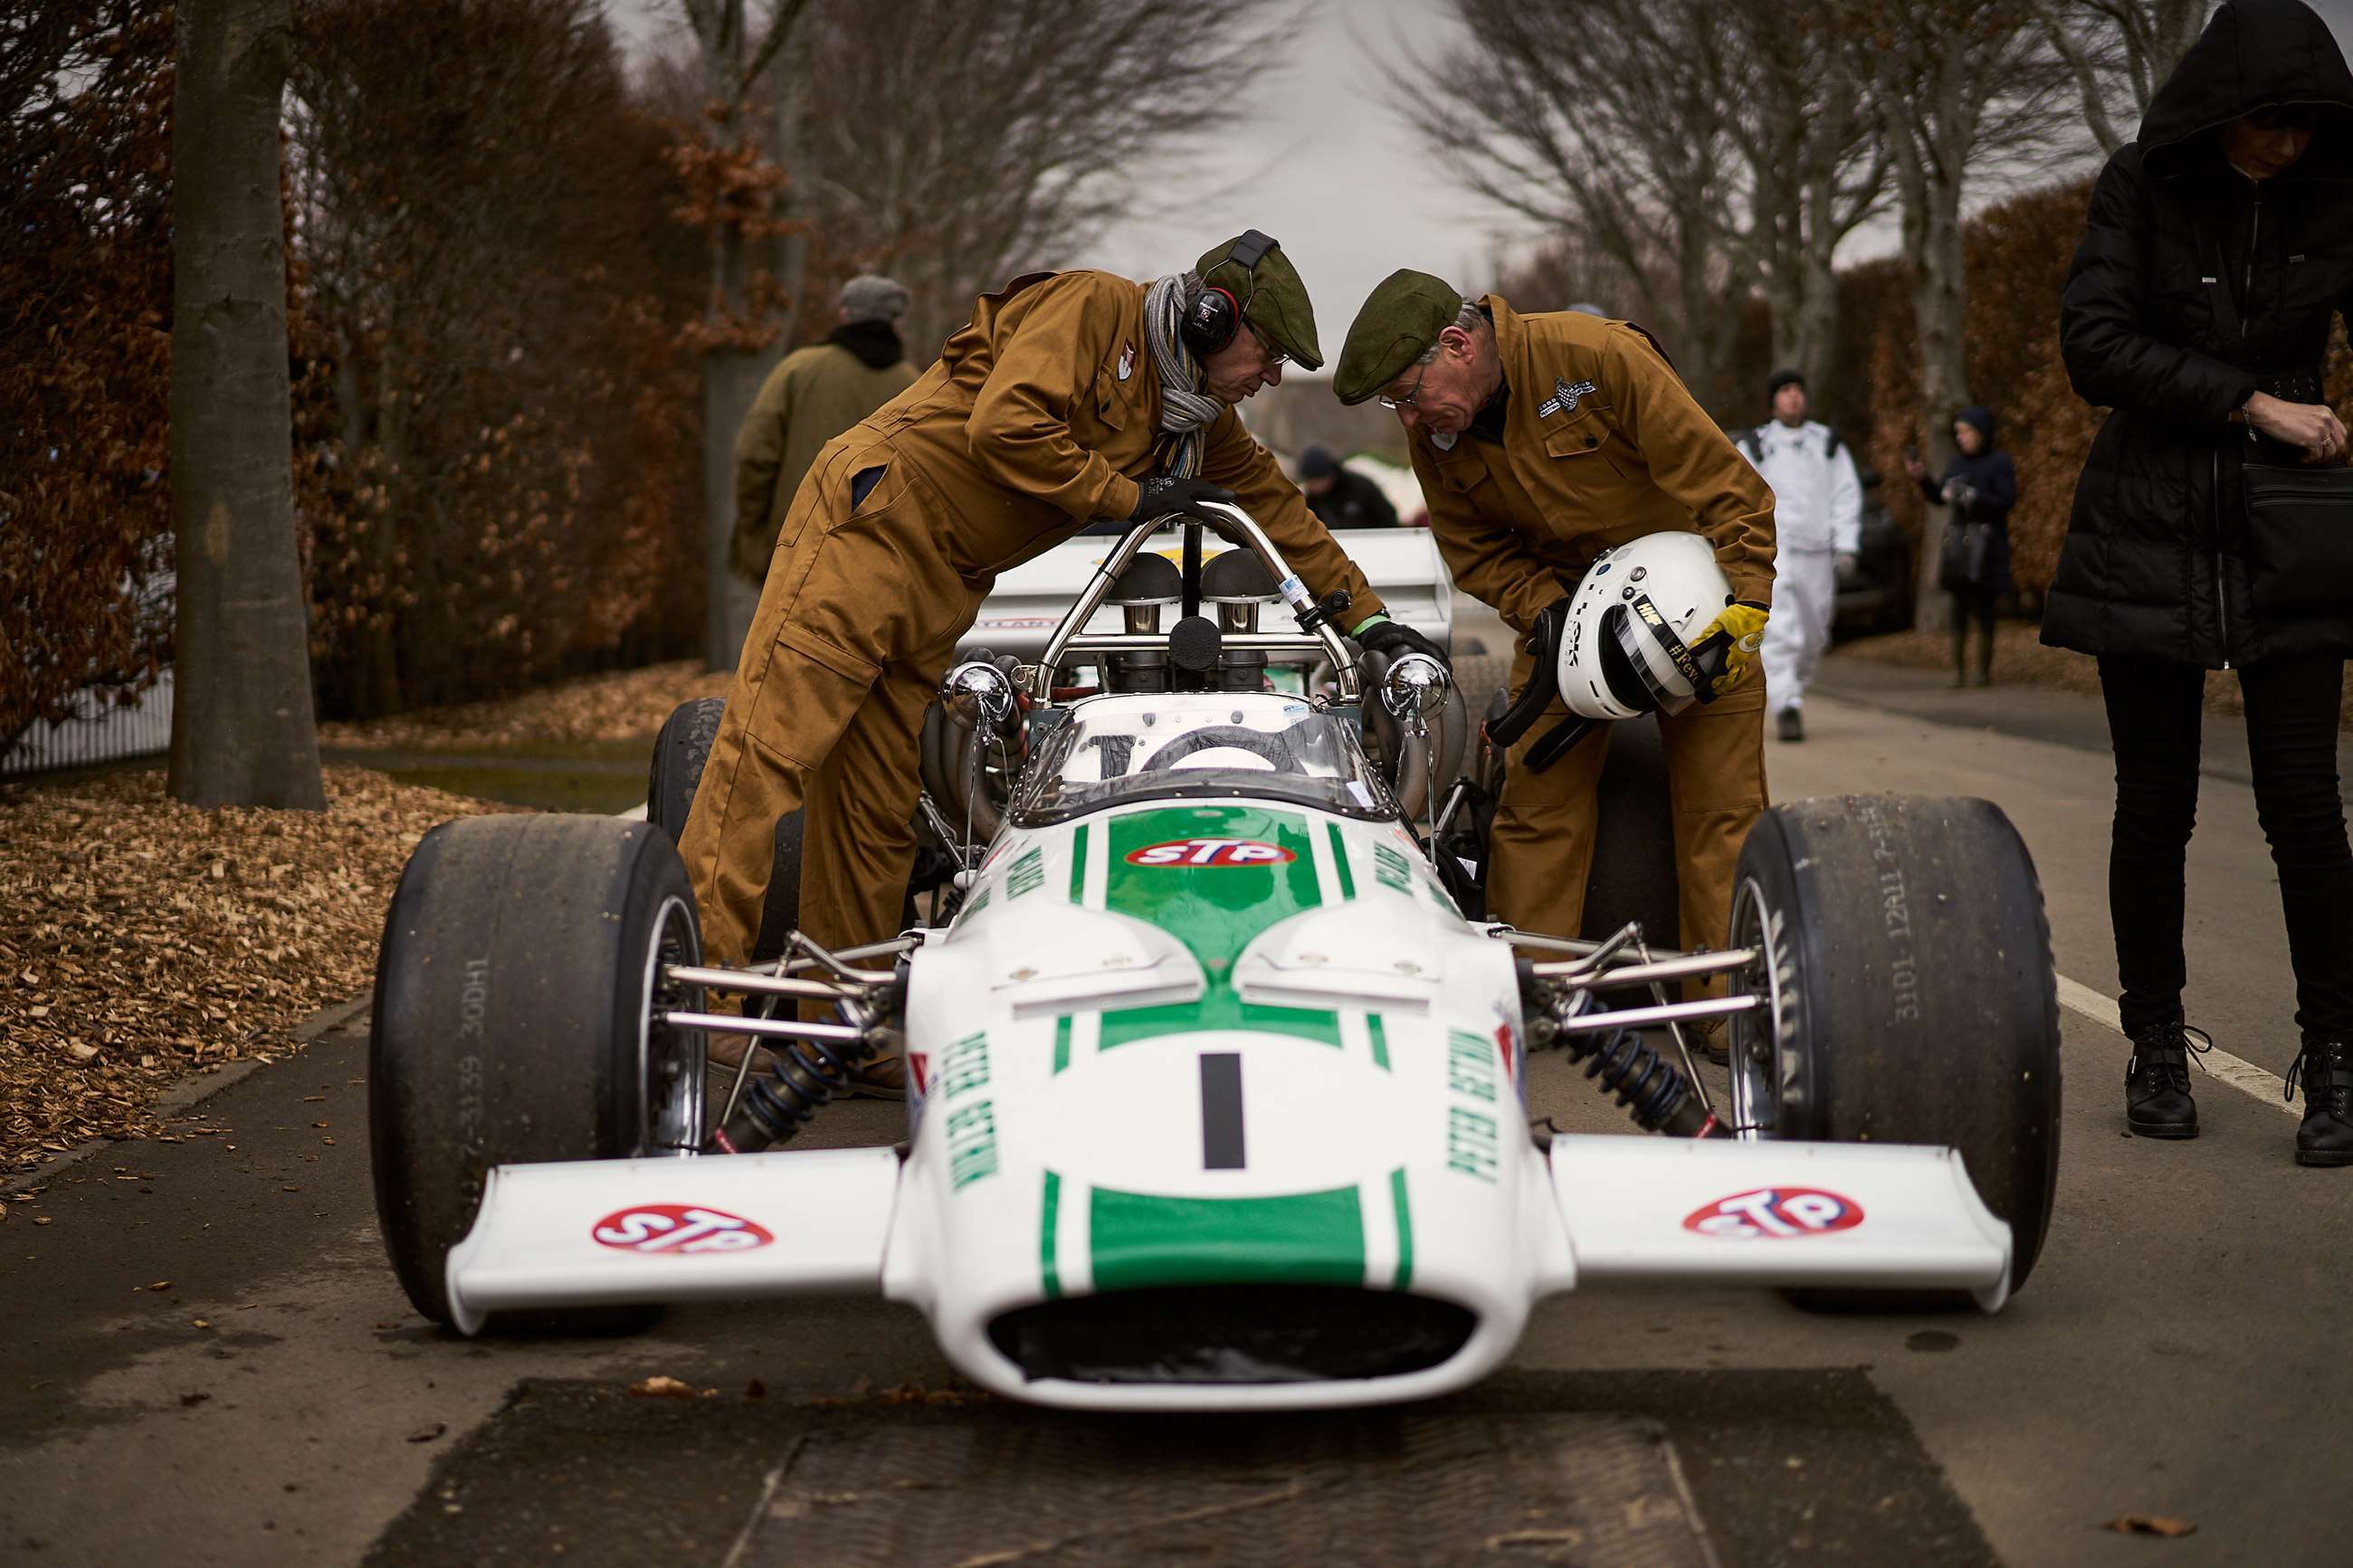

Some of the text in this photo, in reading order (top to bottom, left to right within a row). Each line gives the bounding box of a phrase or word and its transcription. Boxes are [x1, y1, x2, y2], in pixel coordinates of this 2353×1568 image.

[1138, 840, 1279, 864] STP
[1200, 1053, 1245, 1169] 1
[596, 1209, 761, 1252] STP
[1697, 1189, 1843, 1237] STP
